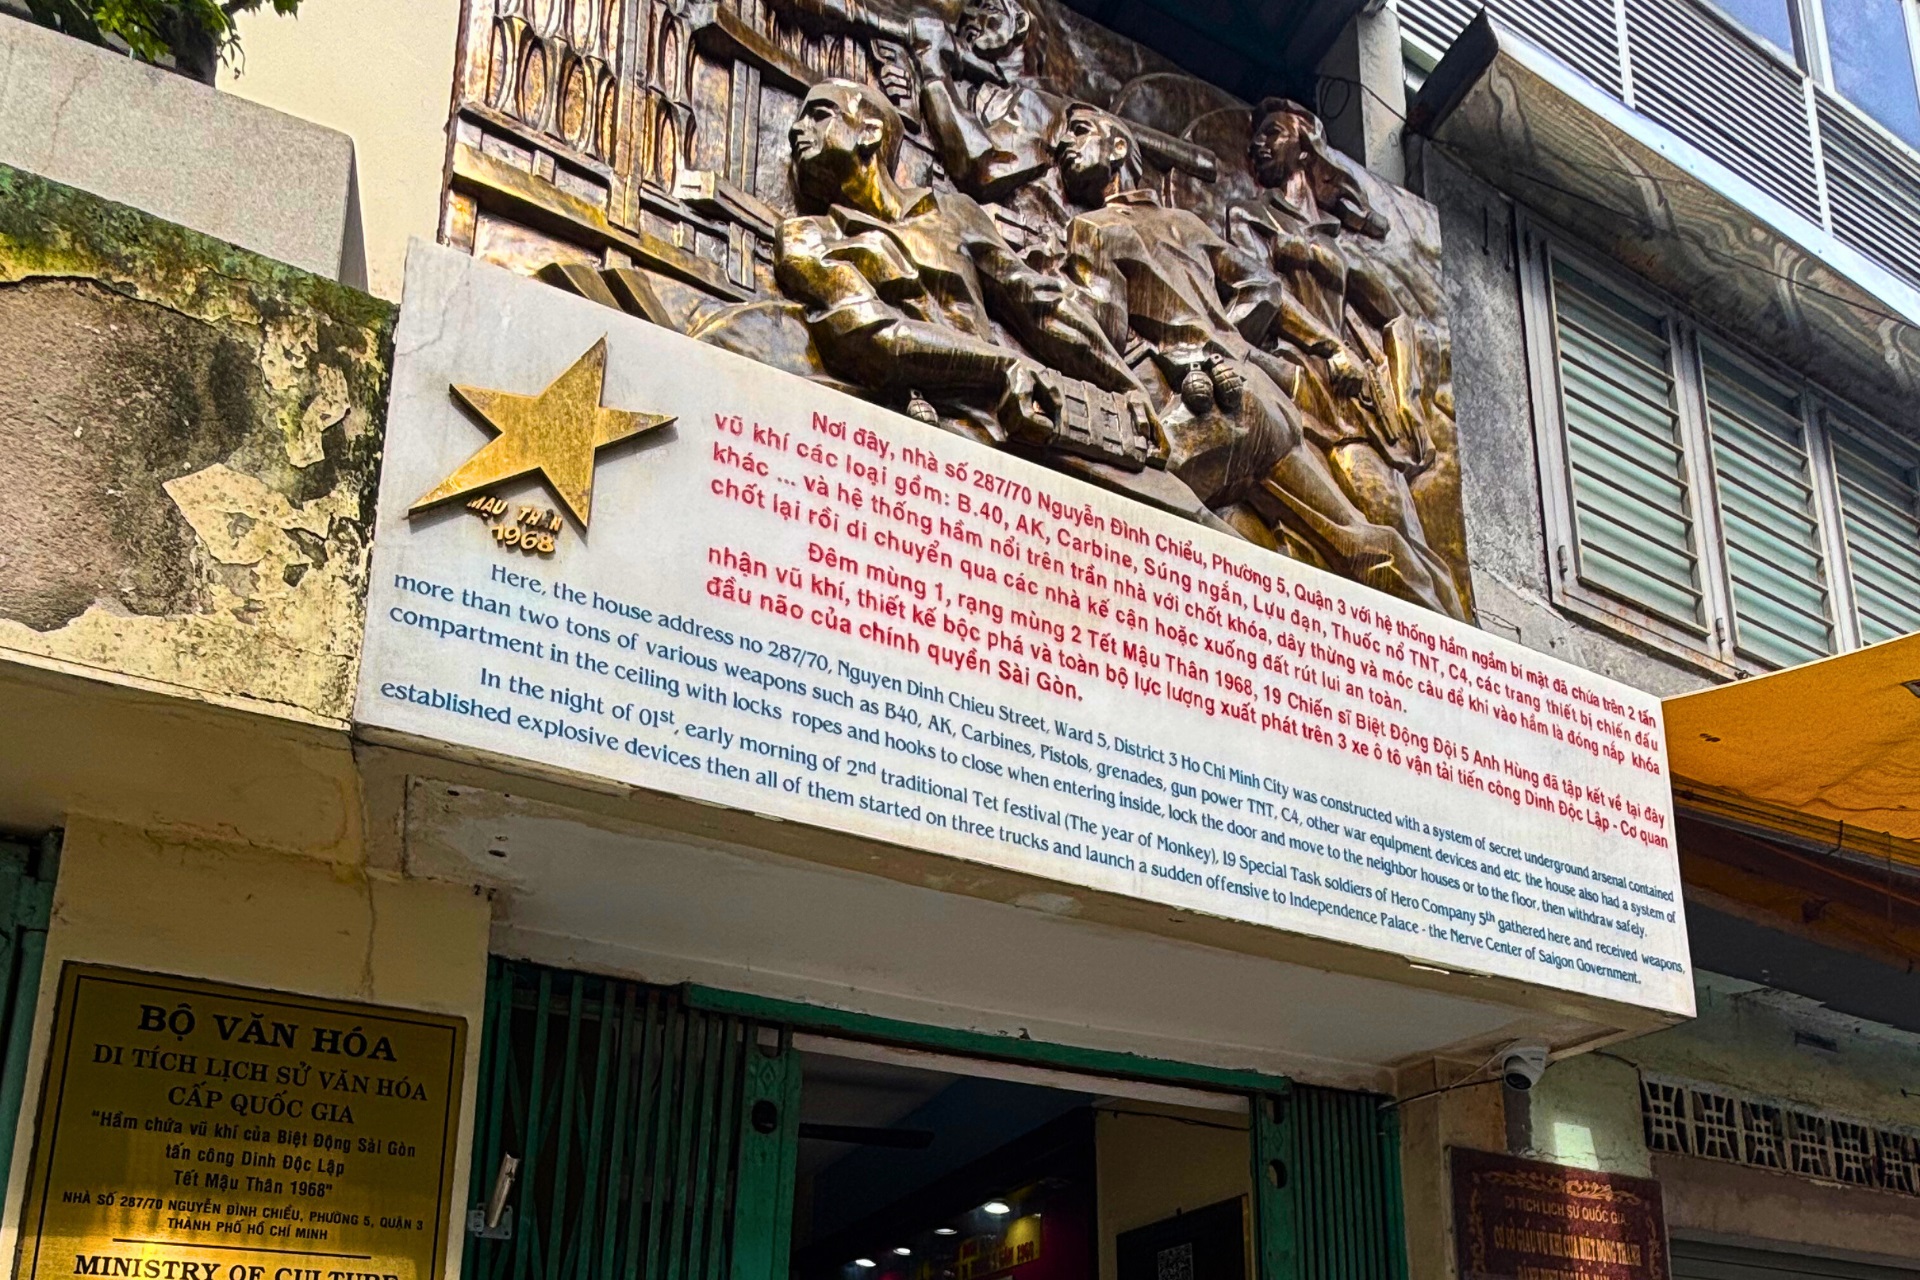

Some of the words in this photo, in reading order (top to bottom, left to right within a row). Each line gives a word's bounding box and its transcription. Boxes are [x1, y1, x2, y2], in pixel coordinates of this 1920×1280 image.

[491, 523, 555, 553] 1968
[811, 410, 847, 442] Nơi
[852, 426, 896, 462] đây,
[901, 446, 940, 474] nhà
[943, 461, 970, 483] số
[972, 468, 1033, 507] 287/70
[1037, 490, 1106, 533] Nguyễn
[1109, 516, 1151, 548] Đình
[1154, 532, 1209, 571] Chiểu,
[1211, 551, 1273, 595] Phường
[1275, 575, 1291, 599] 5,
[1293, 582, 1335, 613] Quận
[1336, 597, 1348, 617] 3
[1349, 604, 1373, 626] với
[1374, 610, 1394, 637] hệ
[1394, 619, 1437, 653] thống
[1509, 659, 1524, 681] bí
[1524, 669, 1551, 691] mật
[1551, 677, 1570, 697] đã
[1570, 685, 1601, 709] chứa
[1600, 695, 1627, 718] trên
[1626, 704, 1637, 722] 2
[709, 477, 767, 511] chốt
[772, 492, 802, 522] lại
[807, 505, 841, 534] rồi
[845, 518, 868, 543] di
[873, 528, 954, 570] chuyển
[959, 558, 998, 585] qua
[1002, 571, 1039, 597] các
[1044, 585, 1082, 611] nhà
[1086, 594, 1111, 620] kế
[1114, 607, 1150, 634] cận
[1154, 615, 1200, 649] hoặc
[1202, 635, 1258, 672] xuống
[1261, 652, 1291, 678] đất
[1293, 663, 1319, 687] rút
[1320, 669, 1342, 693] lui
[1344, 681, 1365, 701] an
[1367, 686, 1408, 715] toàn.
[490, 562, 548, 597] Here,
[552, 580, 588, 607] the
[591, 590, 654, 625] house
[656, 613, 735, 647] address
[738, 635, 764, 655] no
[766, 639, 834, 676] 287/70,
[836, 658, 903, 694] Nguyen
[906, 678, 945, 705] Dinh
[947, 690, 995, 719] Chieu
[997, 704, 1051, 735] Street,
[1053, 718, 1095, 746] Ward
[1096, 731, 1112, 752] 5,
[1113, 735, 1167, 766] District
[1167, 750, 1179, 768] 3
[1180, 753, 1202, 774] Ho
[1201, 760, 1227, 781] Chi
[1228, 766, 1262, 791] Minh
[1262, 776, 1290, 801] City
[1291, 786, 1319, 805] was
[1319, 794, 1394, 826] constructed
[1393, 813, 1422, 834] with
[1421, 822, 1432, 837] a
[1431, 825, 1474, 848] system
[1473, 835, 1487, 852] of
[1487, 840, 1524, 862] secret
[1523, 850, 1591, 880] underground
[1590, 869, 1629, 890] arsenal
[1627, 879, 1676, 904] contained
[379, 681, 513, 726] established
[516, 713, 620, 752] explosive
[623, 736, 702, 771] devices
[706, 755, 751, 784] then
[754, 768, 779, 790] all
[781, 775, 804, 795] of
[806, 779, 855, 808] them
[857, 794, 922, 823] started
[924, 810, 948, 829] on
[950, 813, 996, 840] three
[998, 825, 1051, 853] trucks
[1051, 840, 1083, 860] and
[1084, 844, 1136, 872] launch
[1137, 860, 1149, 875] a
[1149, 863, 1204, 888] sudden
[1204, 873, 1271, 902] offensive
[1271, 887, 1288, 906] to
[1288, 890, 1379, 926] Independence
[1379, 911, 1420, 935] Palace
[1427, 923, 1449, 942] the
[1449, 927, 1485, 950] Nerve
[1484, 935, 1524, 958] Center
[1523, 945, 1538, 962] of
[1537, 948, 1576, 971] Saigon
[1574, 956, 1643, 986] Government.
[137, 1002, 196, 1042] BỘ
[212, 1011, 299, 1049] VĂN
[310, 1025, 398, 1063] HÓA
[92, 1043, 124, 1066] DI
[131, 1044, 198, 1074] TÍCH
[204, 1057, 269, 1083] LỊCH
[275, 1061, 313, 1087] SỬ
[318, 1068, 370, 1094] VĂN
[375, 1076, 428, 1101] HÓA
[167, 1080, 223, 1109] CẤP
[230, 1089, 304, 1119] QUỐC
[310, 1102, 355, 1125] GIA
[144, 1116, 183, 1134] chứa
[189, 1120, 208, 1137] vũ
[214, 1122, 240, 1140] khí
[243, 1125, 271, 1143] của
[277, 1129, 308, 1149] Biệt
[313, 1132, 351, 1154] Động
[357, 1137, 382, 1154] Sài
[387, 1140, 416, 1158] Gòn
[165, 1142, 191, 1161] tấn
[197, 1147, 235, 1168] công
[241, 1150, 276, 1169] Dinh
[282, 1154, 312, 1174] Độc
[317, 1157, 345, 1178] Lập
[173, 1168, 199, 1187] Tết
[204, 1172, 239, 1193] Mậu
[245, 1176, 283, 1195] Thân
[62, 1190, 91, 1204] NHÀ
[96, 1190, 118, 1206] SỐ
[119, 1195, 163, 1210] 287/70
[226, 1202, 257, 1218] ĐÌNH
[262, 1204, 304, 1223] CHIỂU,
[363, 1215, 374, 1228] 5,
[167, 1213, 211, 1232] THÀNH
[215, 1218, 245, 1234] PHỐ
[246, 1220, 266, 1236] HỒ
[269, 1224, 292, 1238] CHÍ
[295, 1227, 328, 1240] MINH
[73, 1254, 221, 1280] MINISTRY
[229, 1264, 266, 1280] OF
